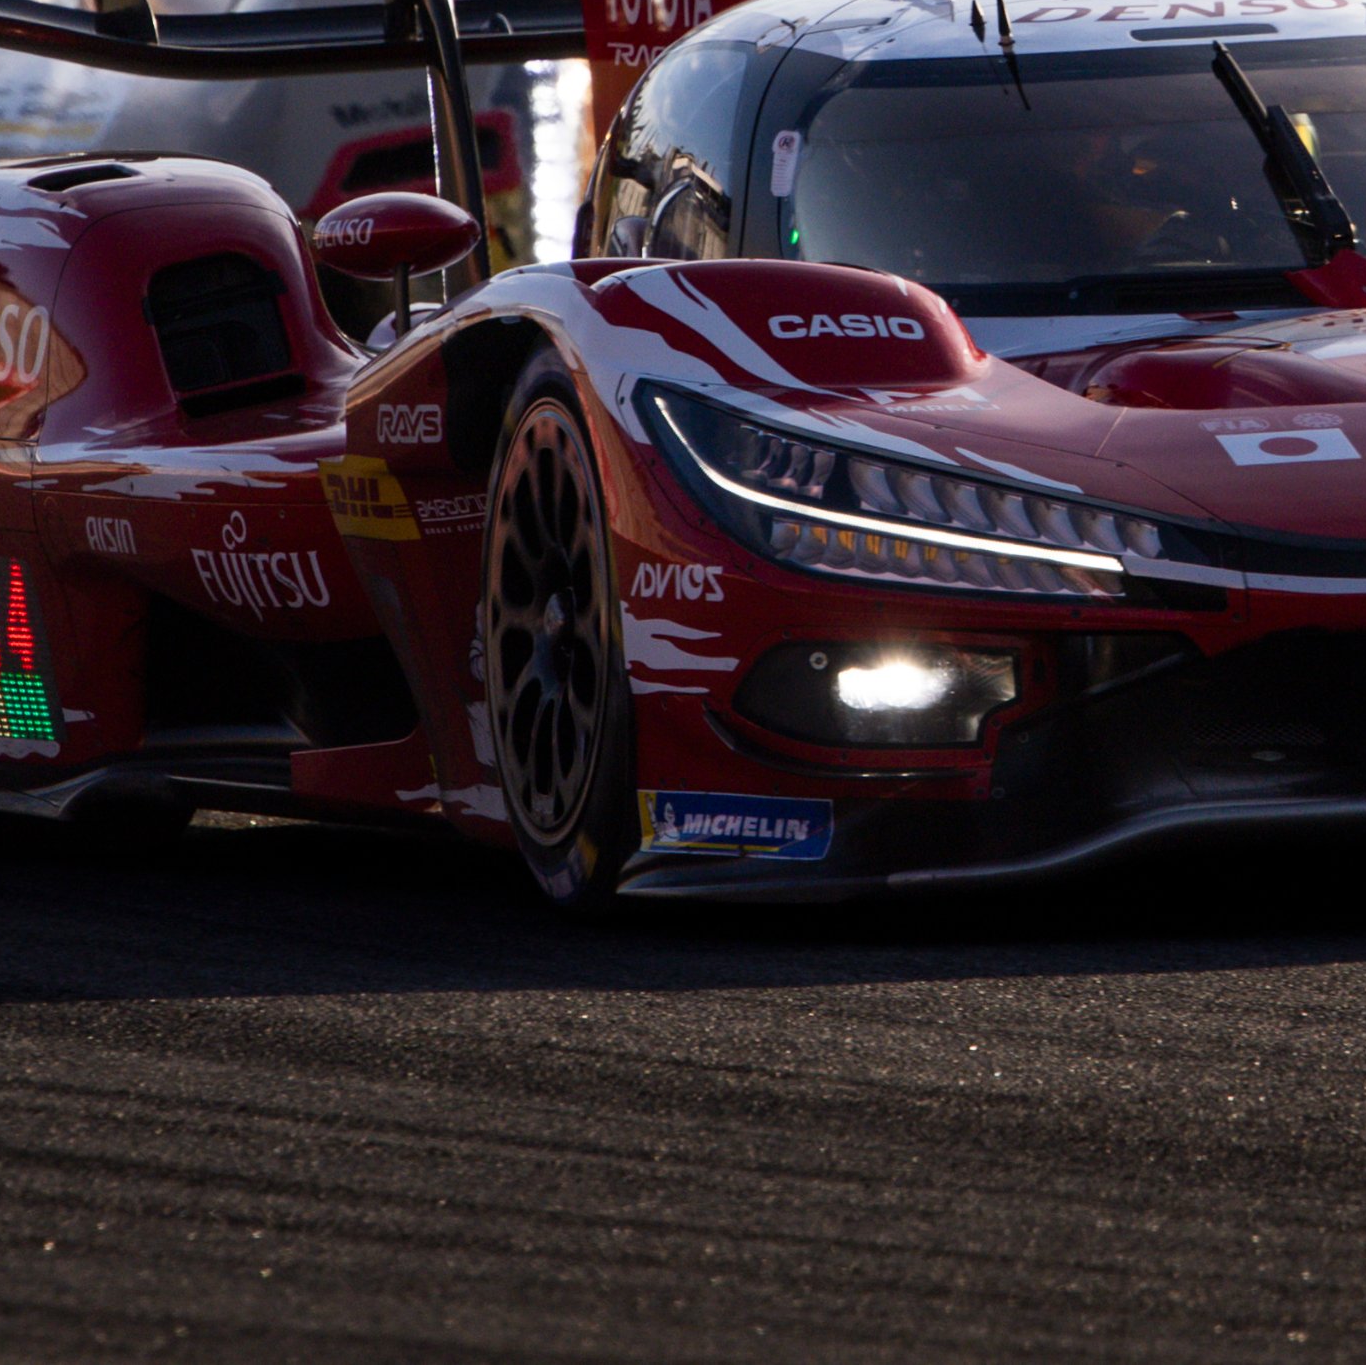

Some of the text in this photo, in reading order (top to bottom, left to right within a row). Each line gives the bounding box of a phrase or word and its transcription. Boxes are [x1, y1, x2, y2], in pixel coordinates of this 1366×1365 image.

[768, 312, 925, 341] CASIO
[376, 403, 443, 444] RAYS
[885, 403, 1002, 414] MARELLI
[327, 473, 394, 519] DHL
[85, 516, 137, 555] AISIN
[191, 548, 331, 622] FUJITSU
[682, 812, 810, 842] MICHELIN
